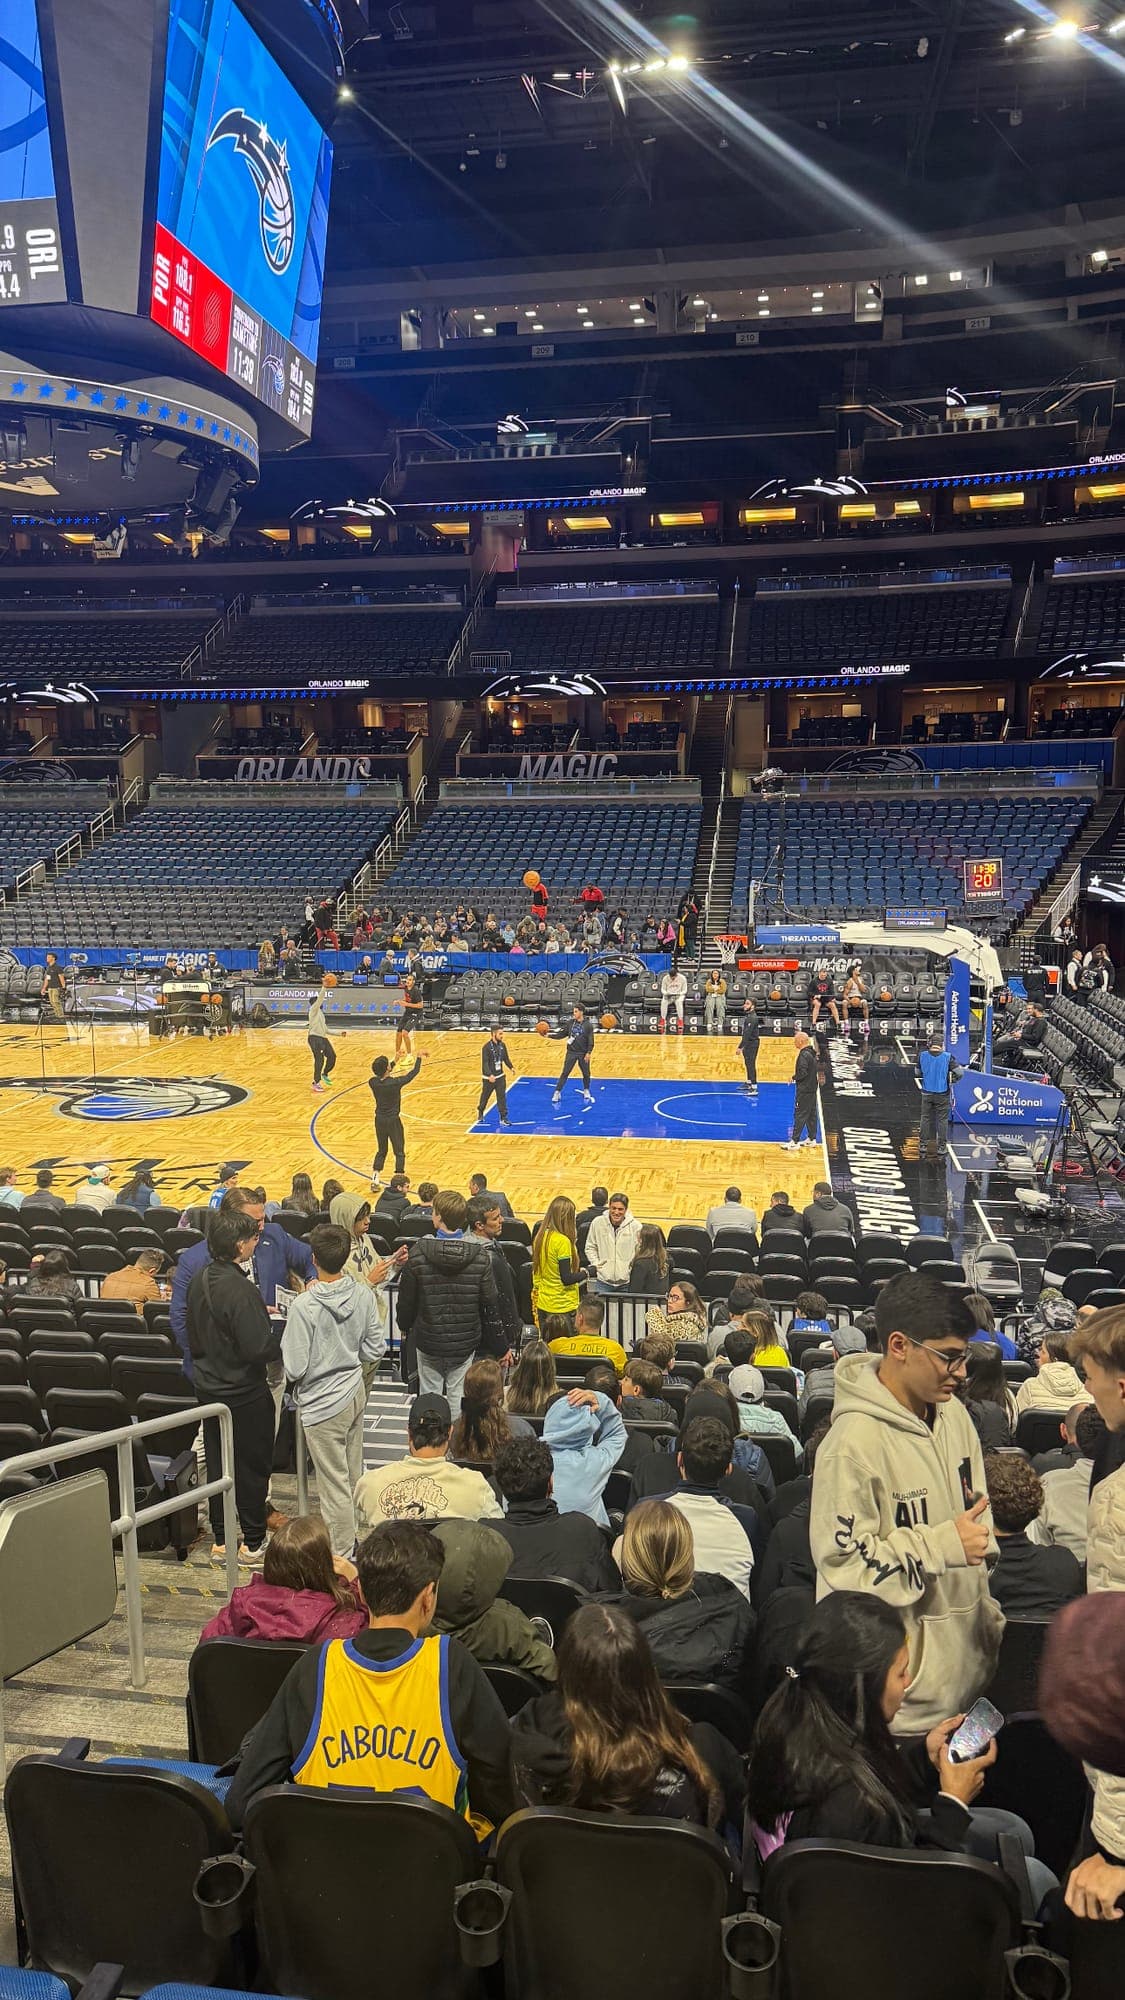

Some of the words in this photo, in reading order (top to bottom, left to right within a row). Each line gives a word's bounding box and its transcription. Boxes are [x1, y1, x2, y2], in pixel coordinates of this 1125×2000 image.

[26, 228, 60, 280] ORL
[154, 252, 171, 307] POR
[589, 488, 622, 496] ORLANDO
[840, 666, 880, 675] ORLANDO
[881, 664, 911, 673] MAGIC
[308, 680, 344, 688] ORLANDO
[518, 753, 618, 779] MAGIC
[974, 874, 993, 888] 20
[165, 951, 208, 966] MGIC
[269, 990, 306, 998] ORLANDO
[307, 990, 334, 998] MAIC
[951, 990, 960, 1045] AdventHealth
[998, 1087, 1019, 1100] City
[998, 1097, 1043, 1107] National
[998, 1106, 1025, 1116] Bank
[842, 1127, 906, 1190] ORLANDO
[855, 1191, 920, 1247] MAG
[892, 1488, 928, 1500] MUHAMMAD
[321, 1724, 441, 1770] CABOCLO
